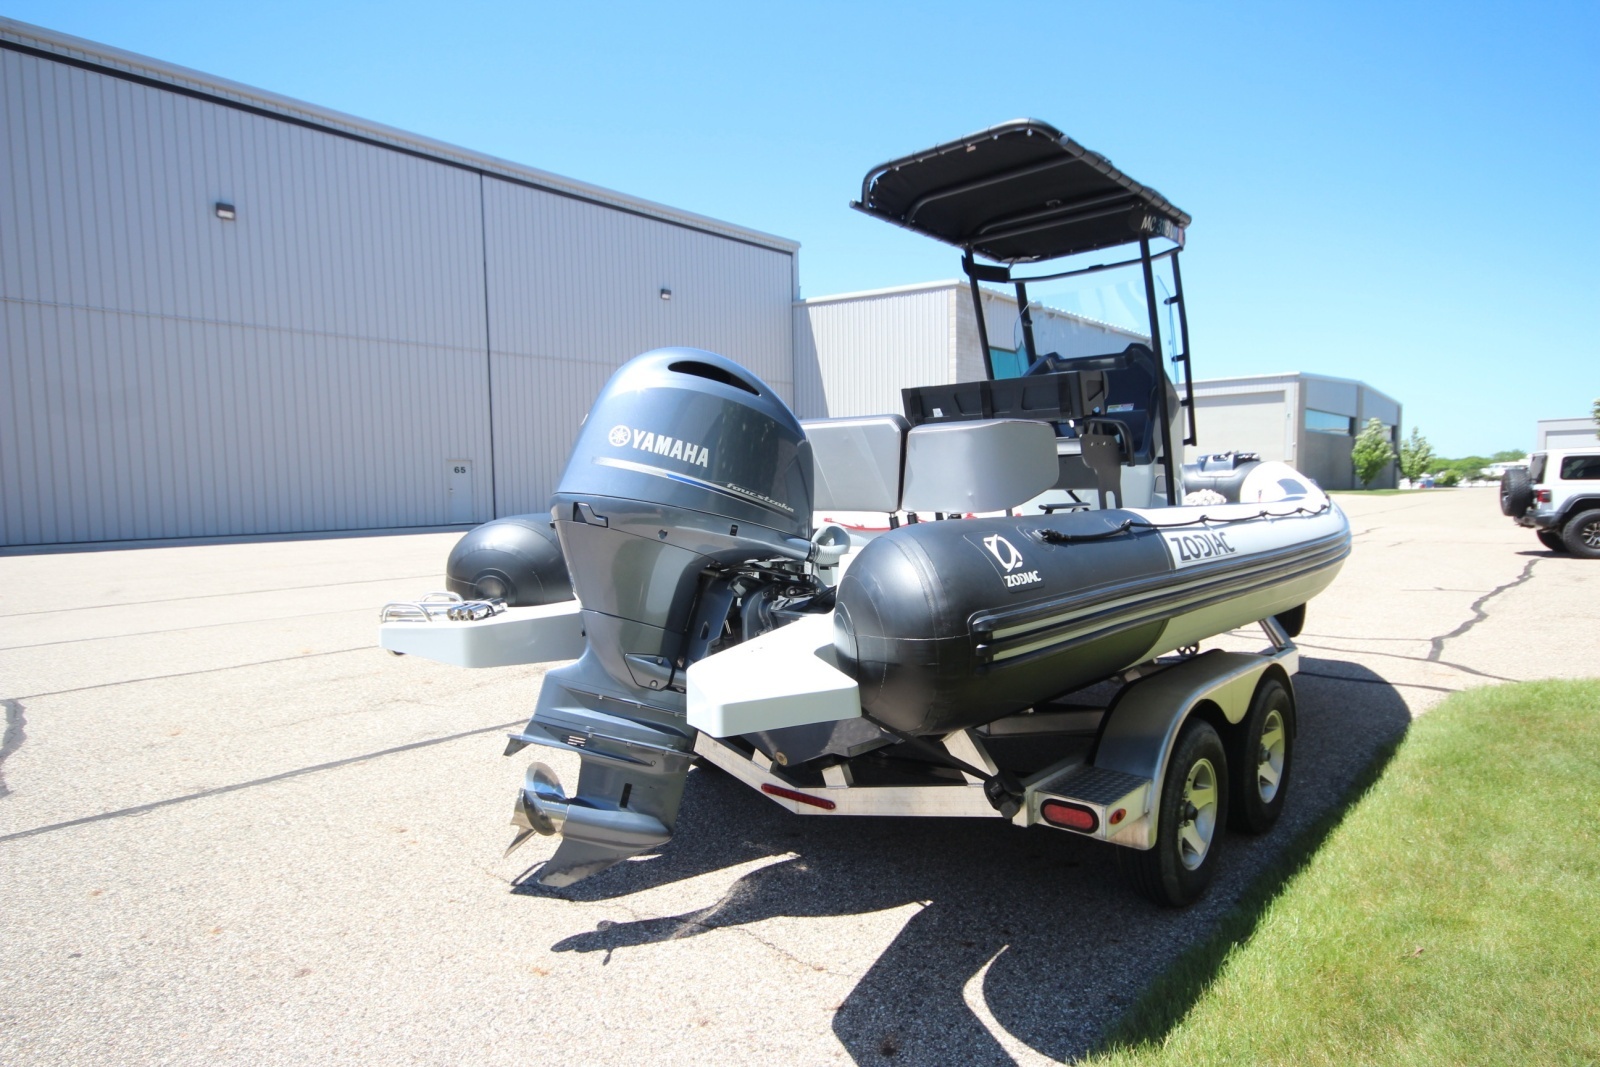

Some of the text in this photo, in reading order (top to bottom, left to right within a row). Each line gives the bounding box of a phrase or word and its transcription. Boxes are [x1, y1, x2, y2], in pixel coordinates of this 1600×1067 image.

[632, 429, 709, 468] YAMAHA
[454, 466, 466, 474] 65
[1170, 531, 1236, 561] ZODIAC
[1004, 570, 1042, 588] ZODIAC
